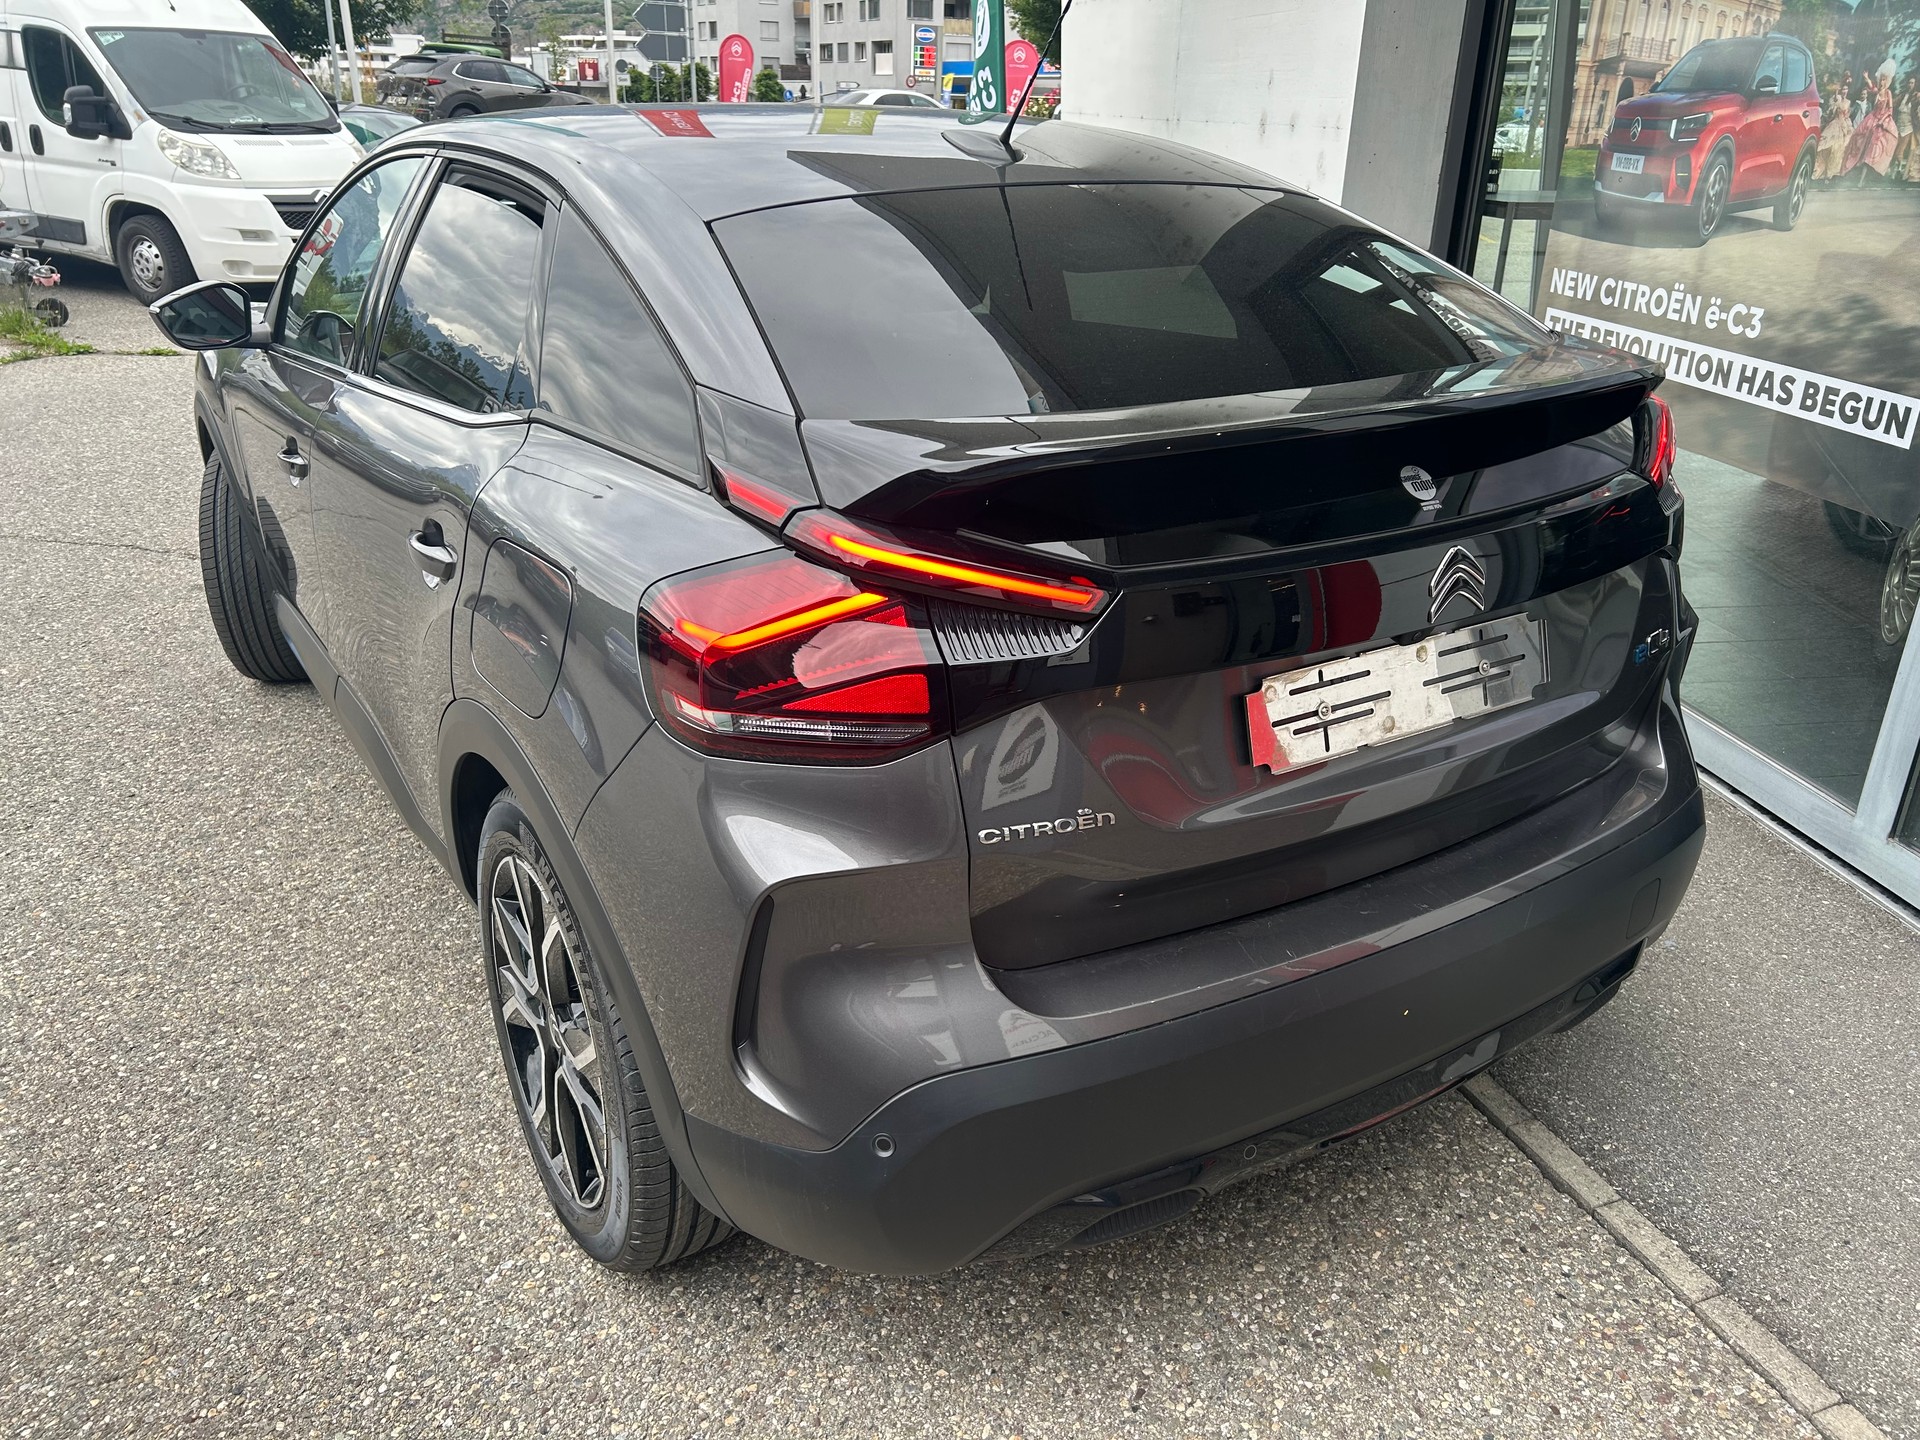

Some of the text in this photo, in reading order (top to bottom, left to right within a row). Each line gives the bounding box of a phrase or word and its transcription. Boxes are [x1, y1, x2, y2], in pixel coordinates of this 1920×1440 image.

[1549, 267, 1766, 340] NEW CITROËN ë-C3
[1735, 363, 1798, 406] HAS
[1798, 380, 1913, 440] BEGUN
